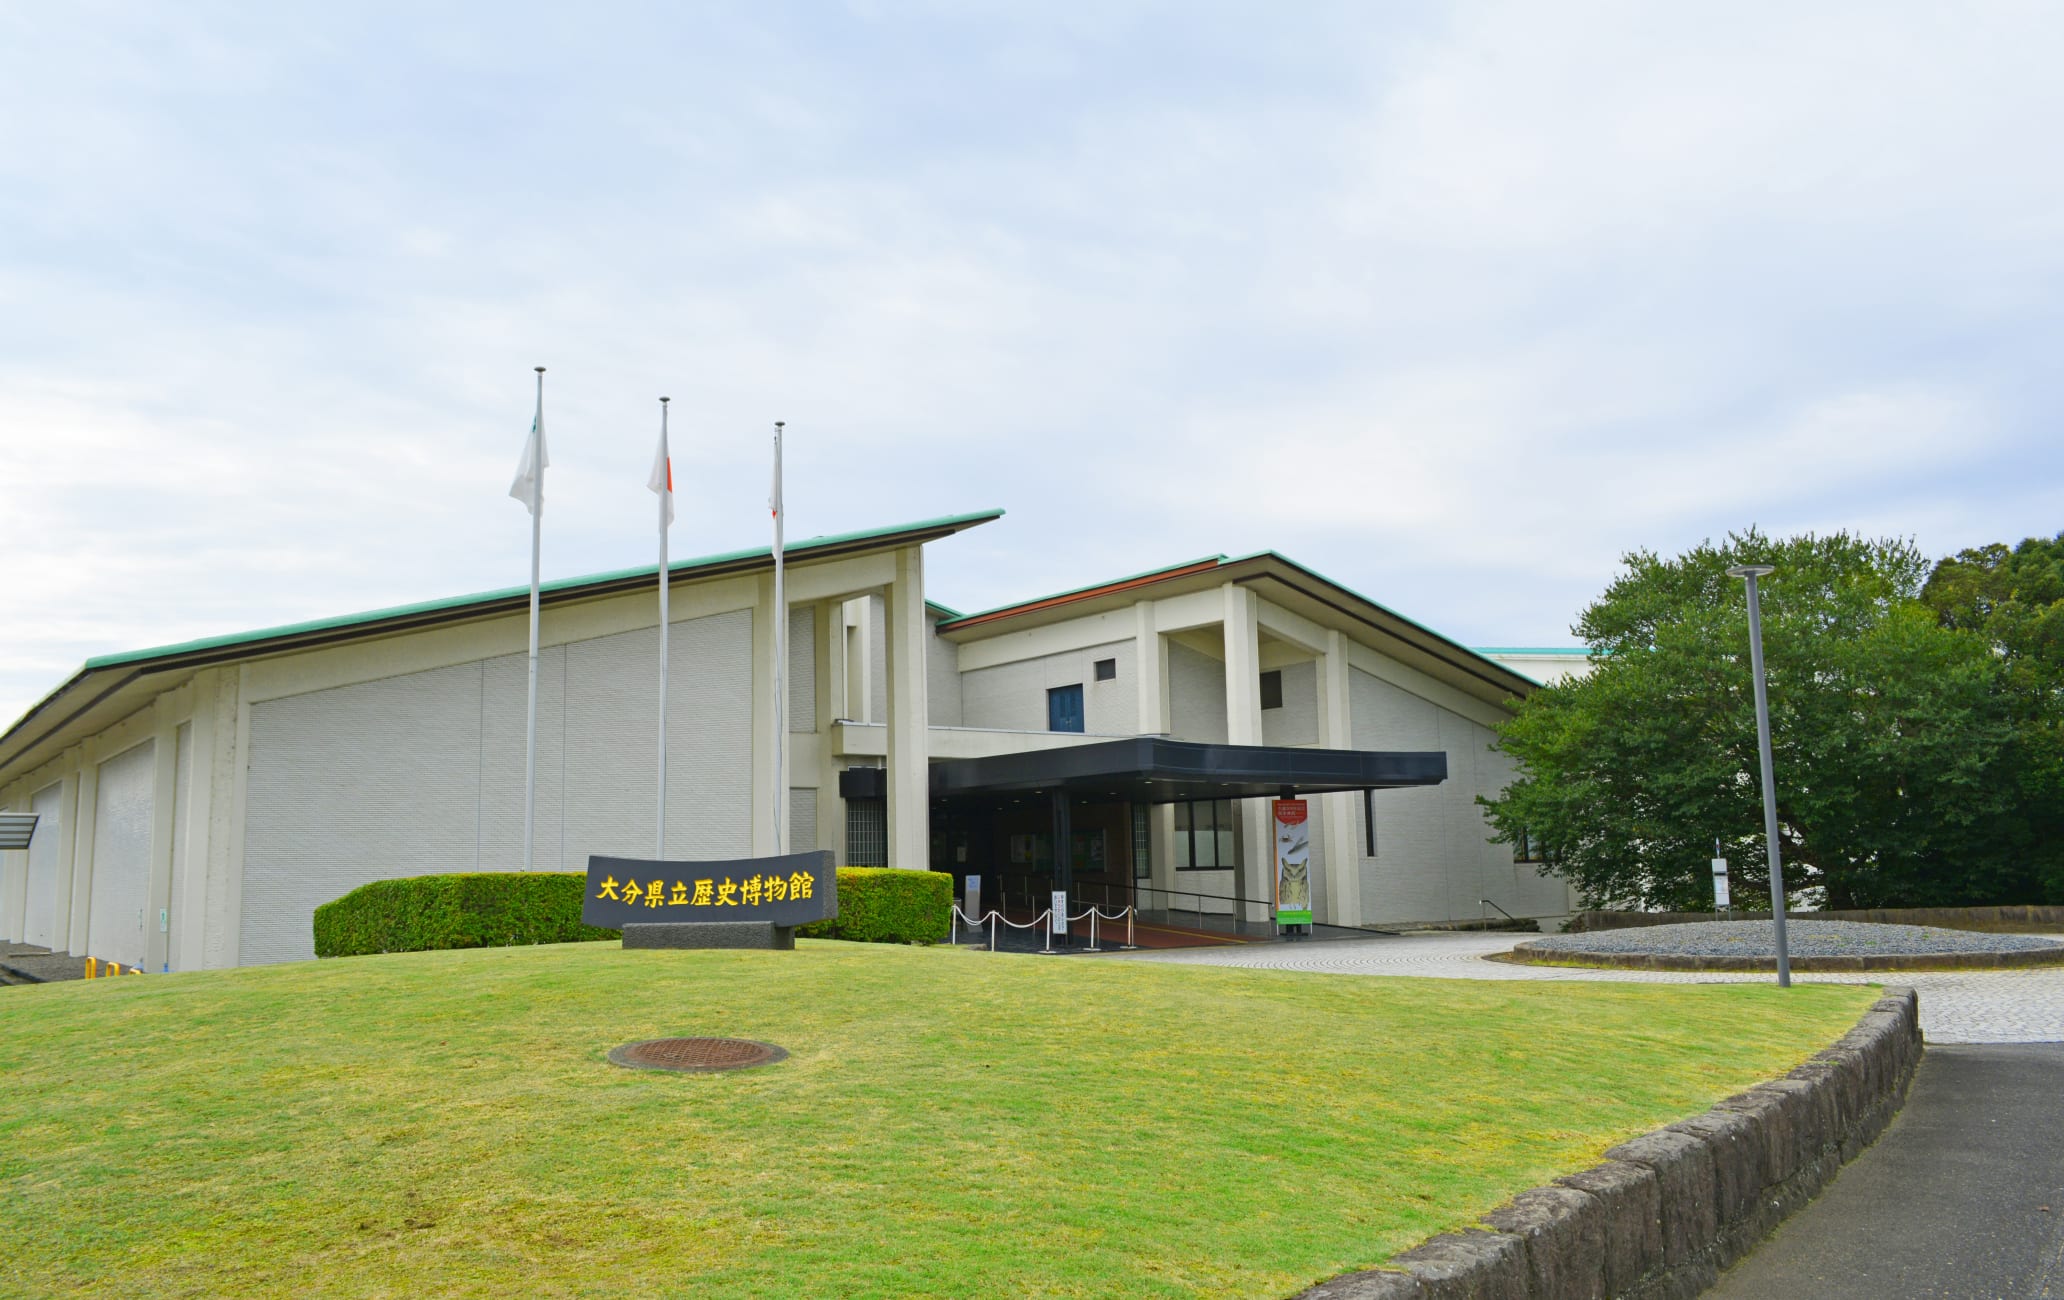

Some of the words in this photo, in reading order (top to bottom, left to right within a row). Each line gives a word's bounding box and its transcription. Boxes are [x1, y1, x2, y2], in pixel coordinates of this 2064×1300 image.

[595, 870, 815, 909] 大分県立歴史博物館
